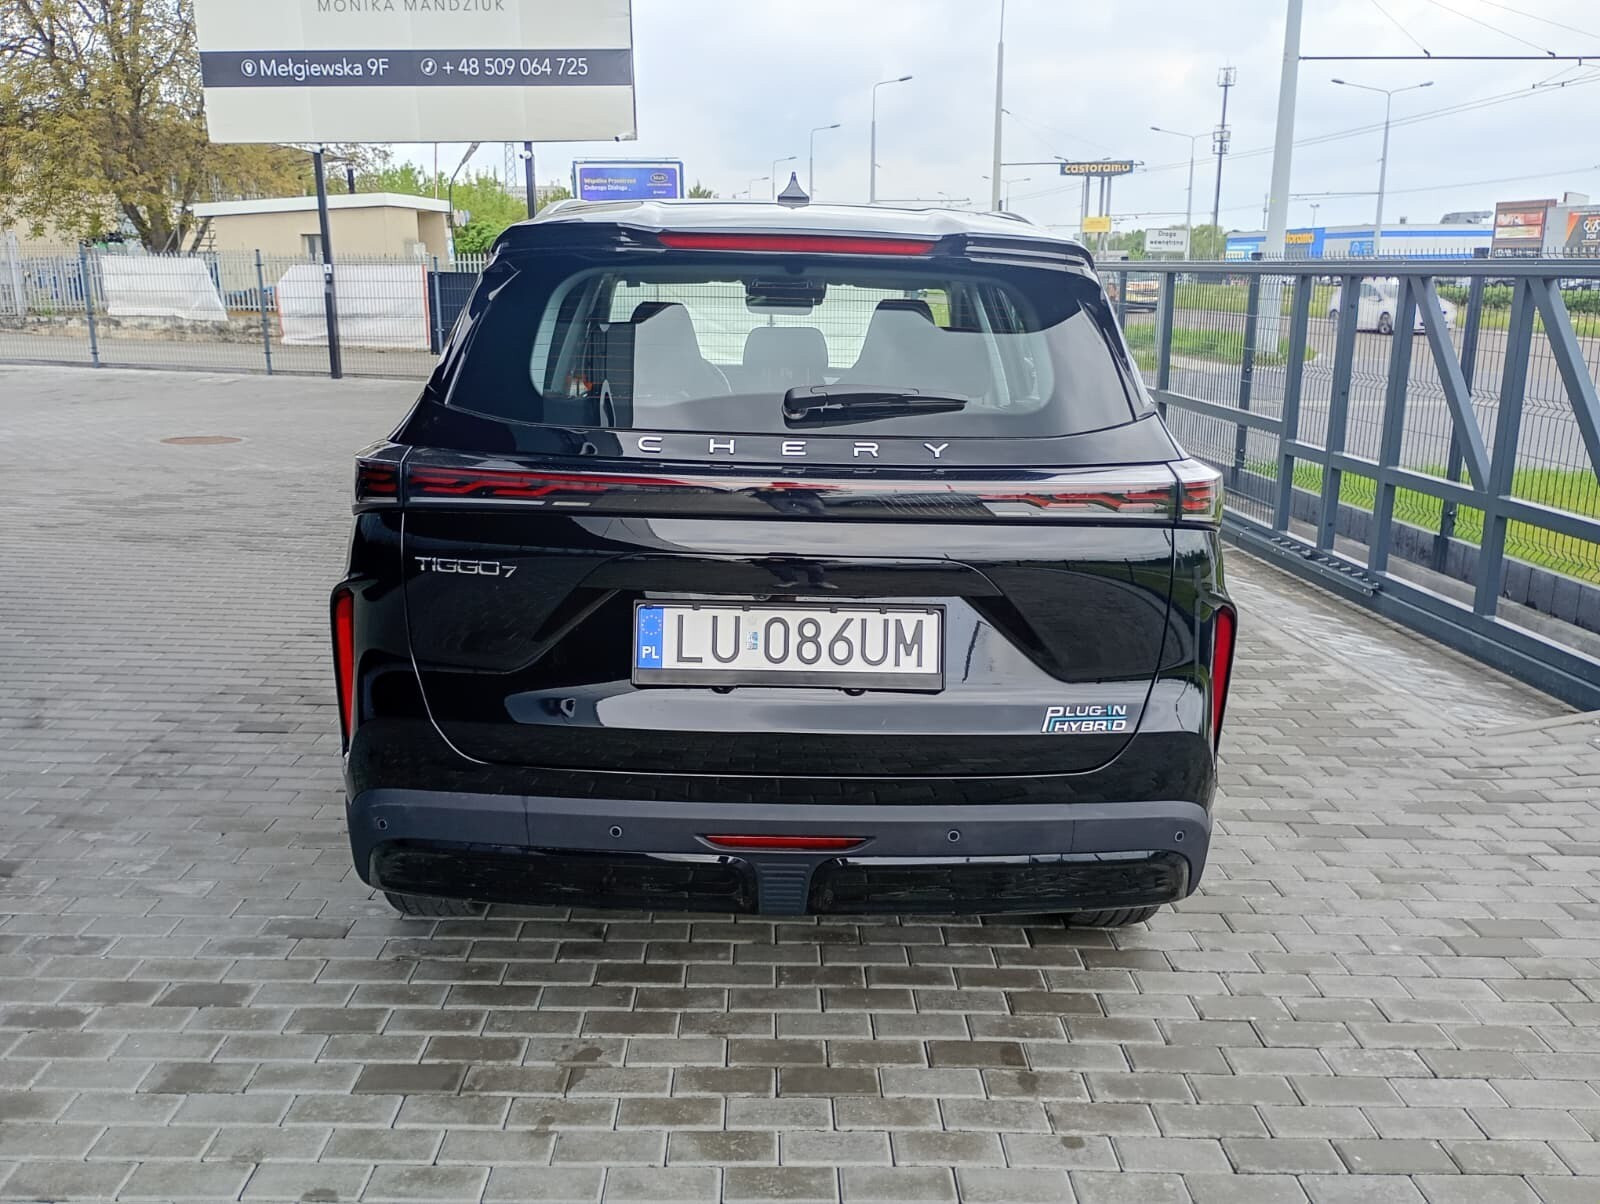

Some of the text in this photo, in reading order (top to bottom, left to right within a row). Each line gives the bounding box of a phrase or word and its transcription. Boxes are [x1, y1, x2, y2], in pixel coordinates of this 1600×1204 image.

[318, 0, 505, 12] MONIKA MANDZIUK
[260, 58, 389, 81] Mełgiewska 9F
[458, 58, 479, 76] 48
[484, 58, 515, 75] 509
[519, 58, 552, 75] 064
[557, 58, 588, 75] 725
[1065, 163, 1130, 174] castorama
[637, 436, 949, 458] CHERY
[642, 614, 924, 668] PL LU 086UM
[1054, 720, 1127, 732] HYBRID
